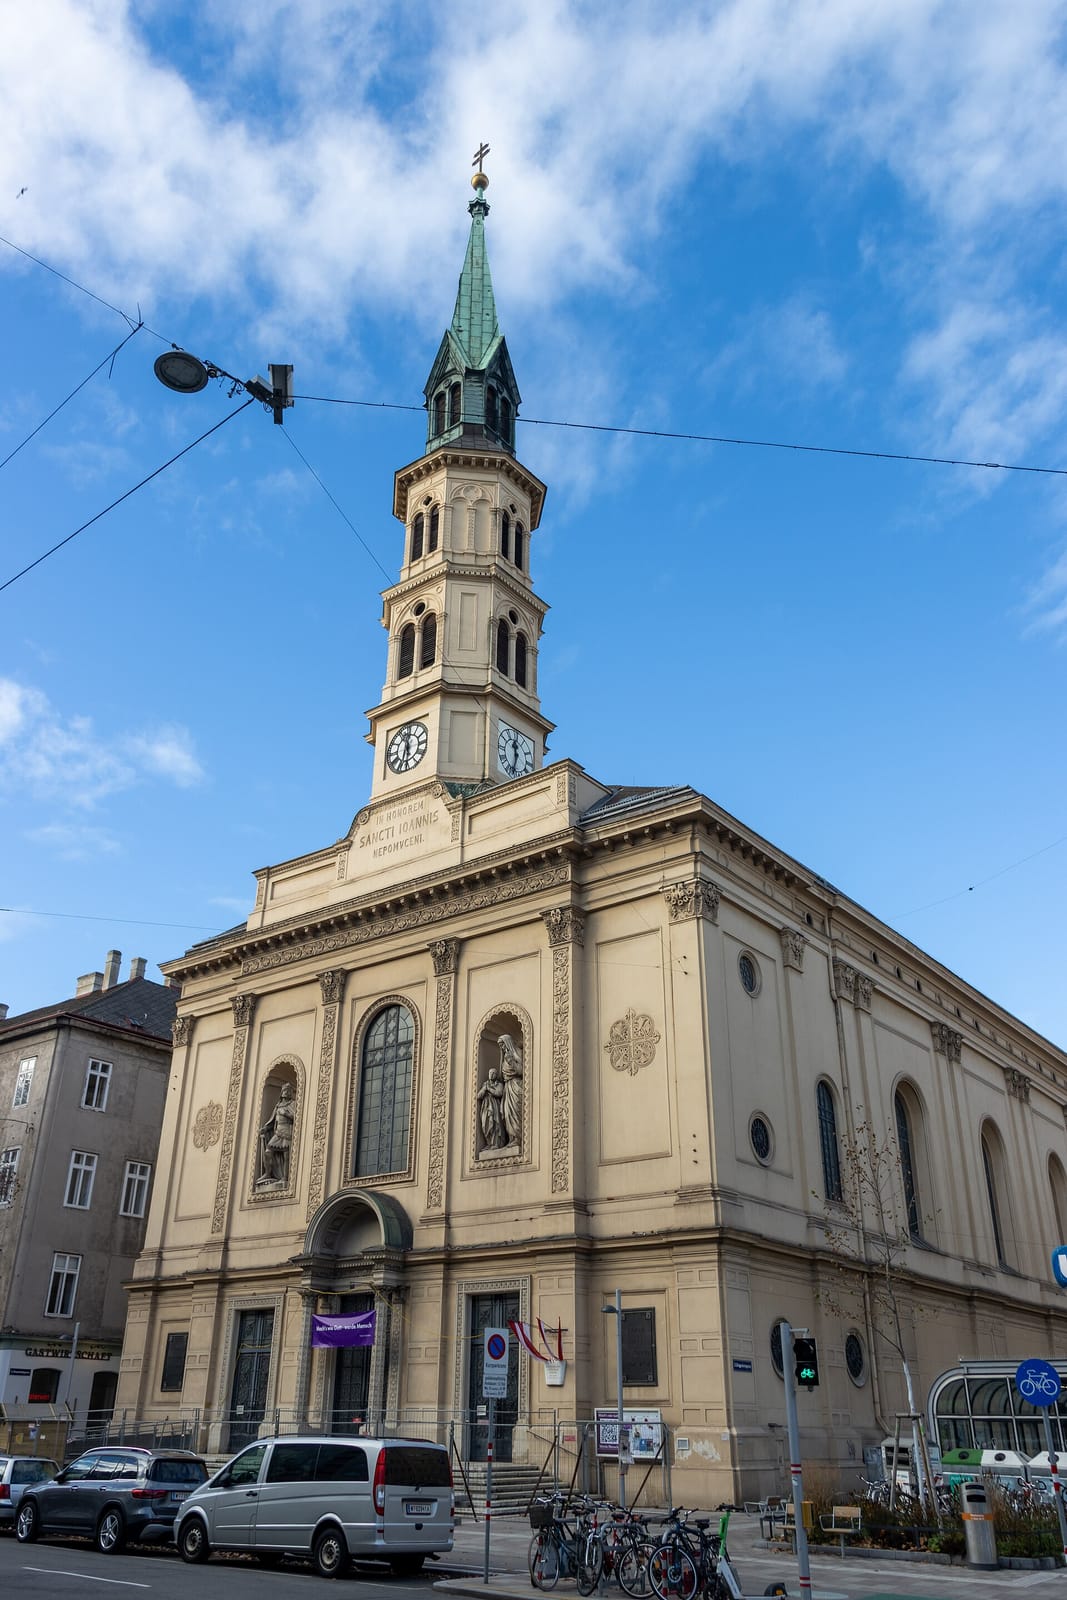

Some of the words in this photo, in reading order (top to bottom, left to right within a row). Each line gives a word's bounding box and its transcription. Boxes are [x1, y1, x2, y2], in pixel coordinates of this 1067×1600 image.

[376, 814, 384, 825] IN
[386, 799, 425, 821] HONOREM
[359, 825, 395, 848] SANCTI
[399, 810, 439, 835] IOANNIS
[25, 1347, 112, 1361] GASTWIRSCHAFT
